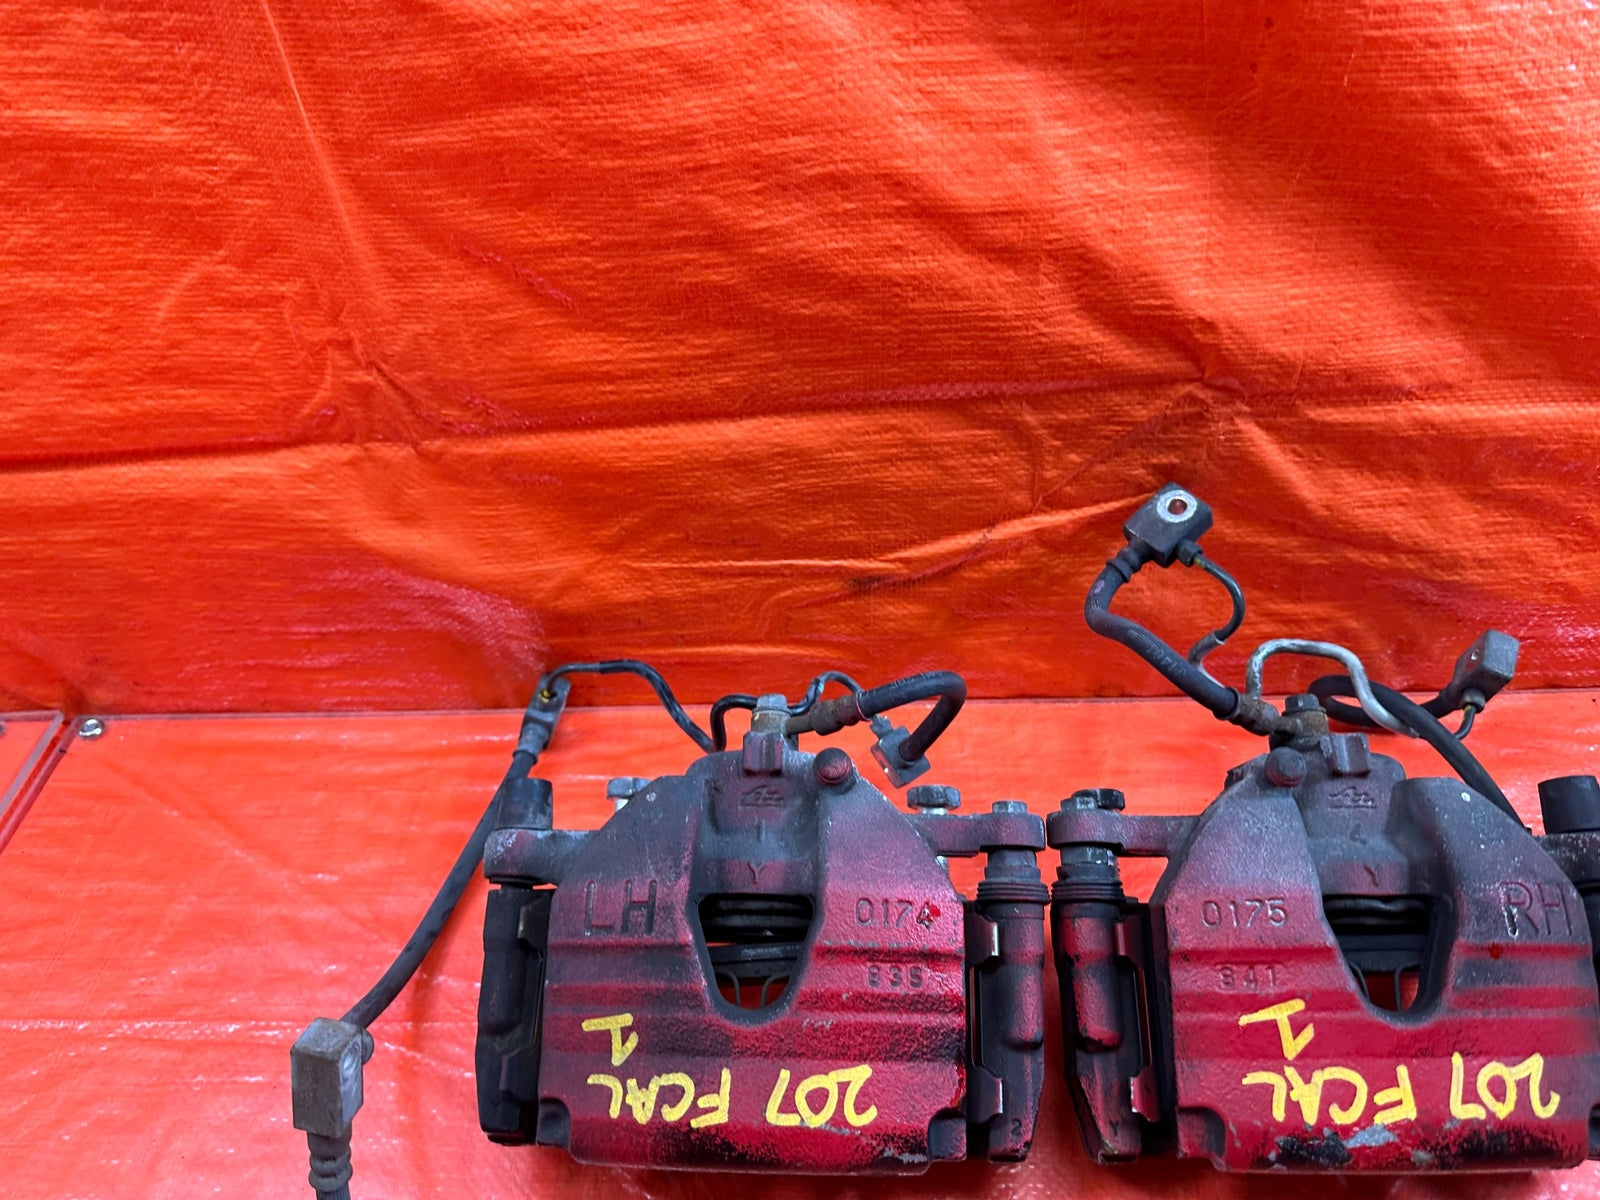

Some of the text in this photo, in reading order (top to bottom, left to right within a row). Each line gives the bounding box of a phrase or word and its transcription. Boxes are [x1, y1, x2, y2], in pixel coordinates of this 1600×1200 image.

[584, 879, 657, 935] LH
[855, 896, 934, 930] 0174
[1200, 895, 1289, 930] 0175
[1499, 881, 1573, 938] RH
[581, 1013, 638, 1063] 1
[1239, 1001, 1313, 1060] 1
[588, 1066, 876, 1129] 207 FCAL
[1243, 1055, 1560, 1124] 207 FCAL
